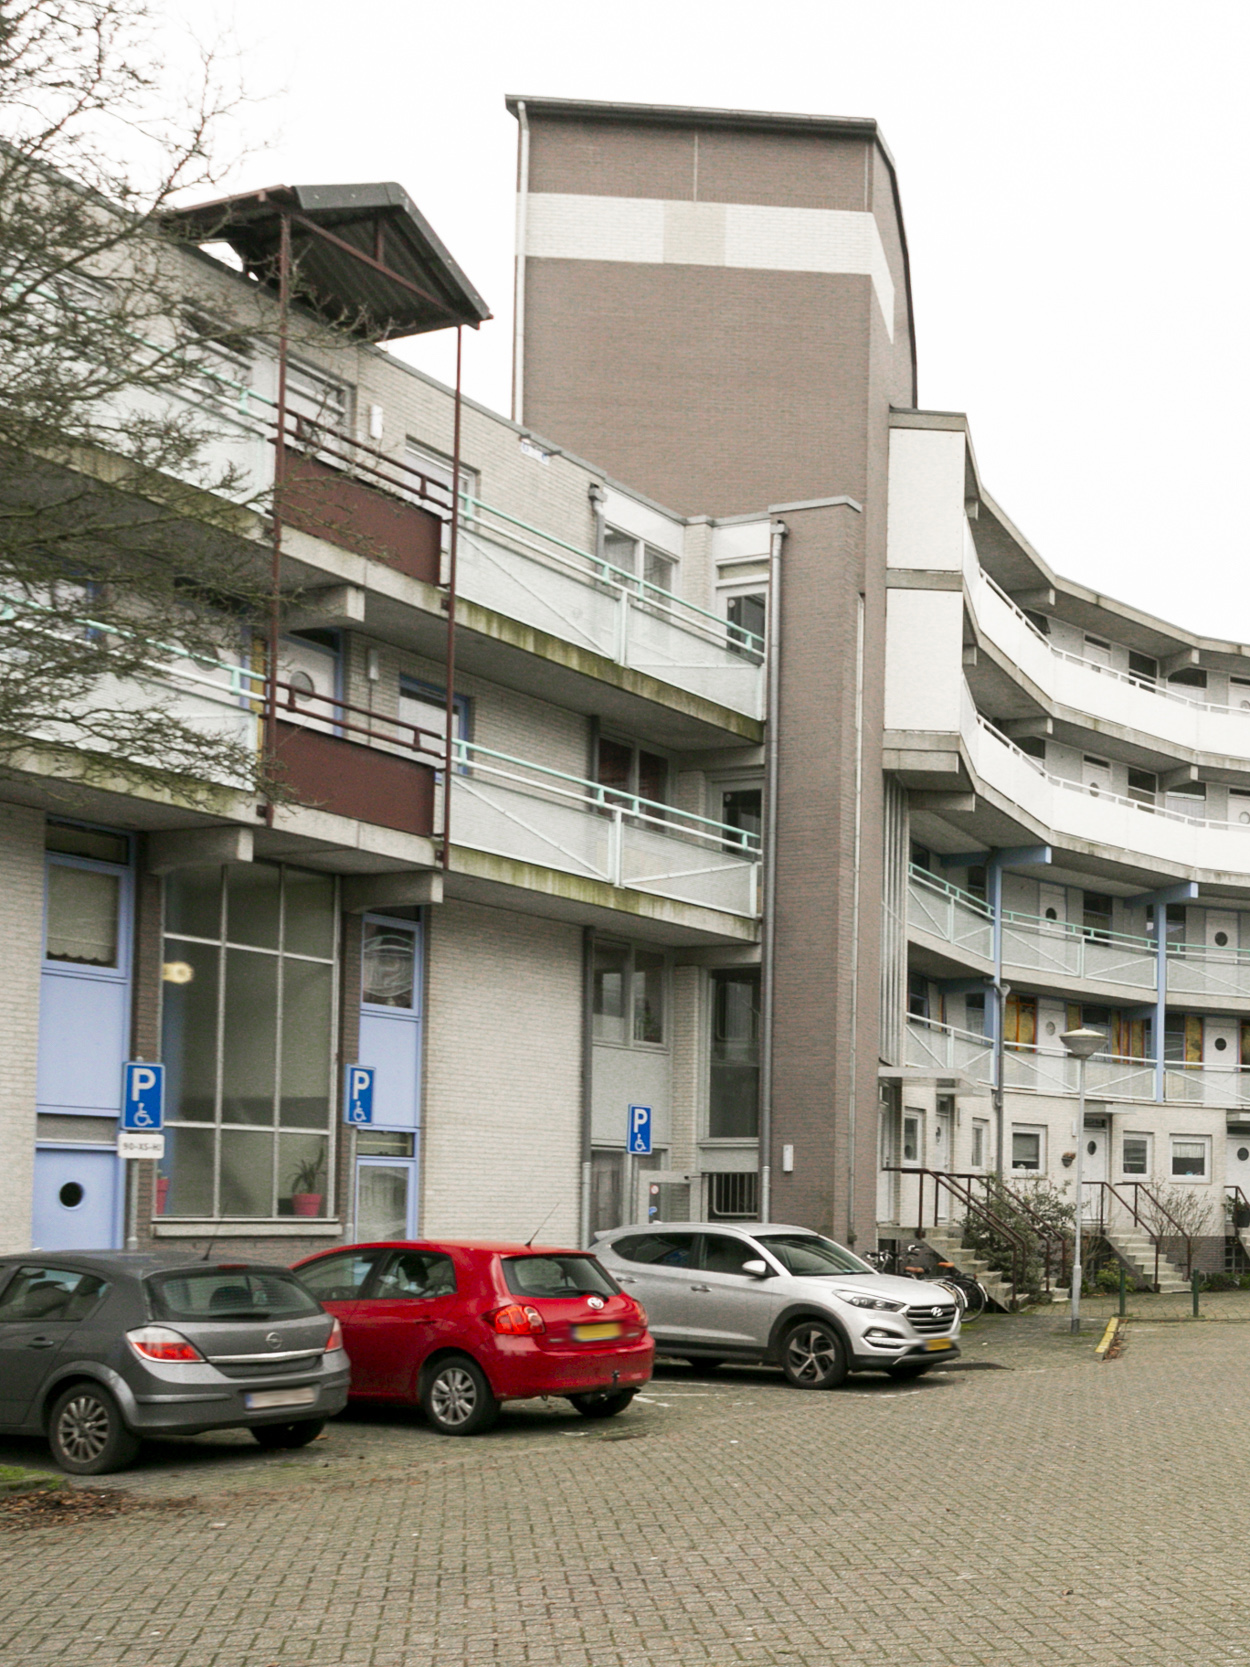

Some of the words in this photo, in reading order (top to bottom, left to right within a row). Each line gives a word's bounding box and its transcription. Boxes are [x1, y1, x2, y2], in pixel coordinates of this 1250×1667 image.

[131, 1067, 156, 1102] P
[352, 1070, 370, 1100] P
[633, 1108, 648, 1133] P
